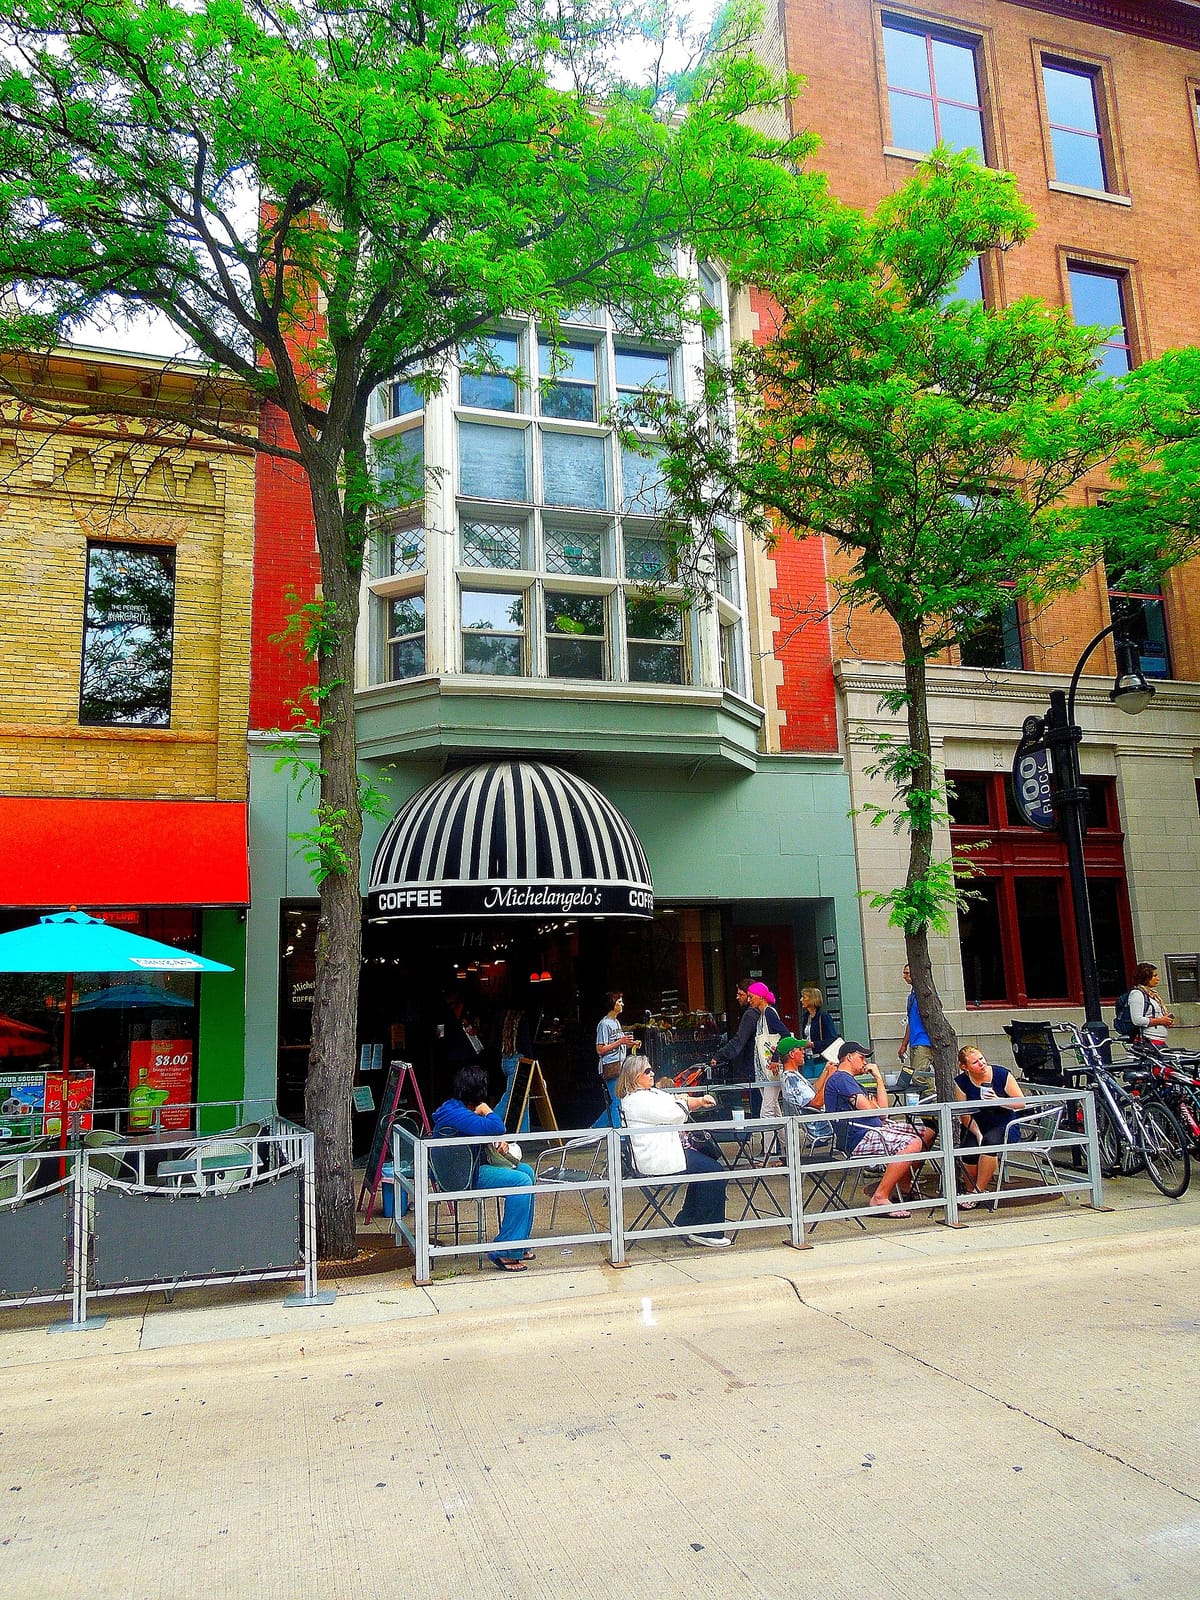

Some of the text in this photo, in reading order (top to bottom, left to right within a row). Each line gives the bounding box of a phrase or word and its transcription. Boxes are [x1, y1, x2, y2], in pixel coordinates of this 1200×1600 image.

[107, 611, 151, 624] MARGARITA
[1020, 756, 1042, 816] 100
[1038, 763, 1053, 814] BLOCK
[378, 889, 442, 911] COFFEE
[484, 886, 602, 912] Michelangelo's
[155, 1054, 188, 1066] $8.00
